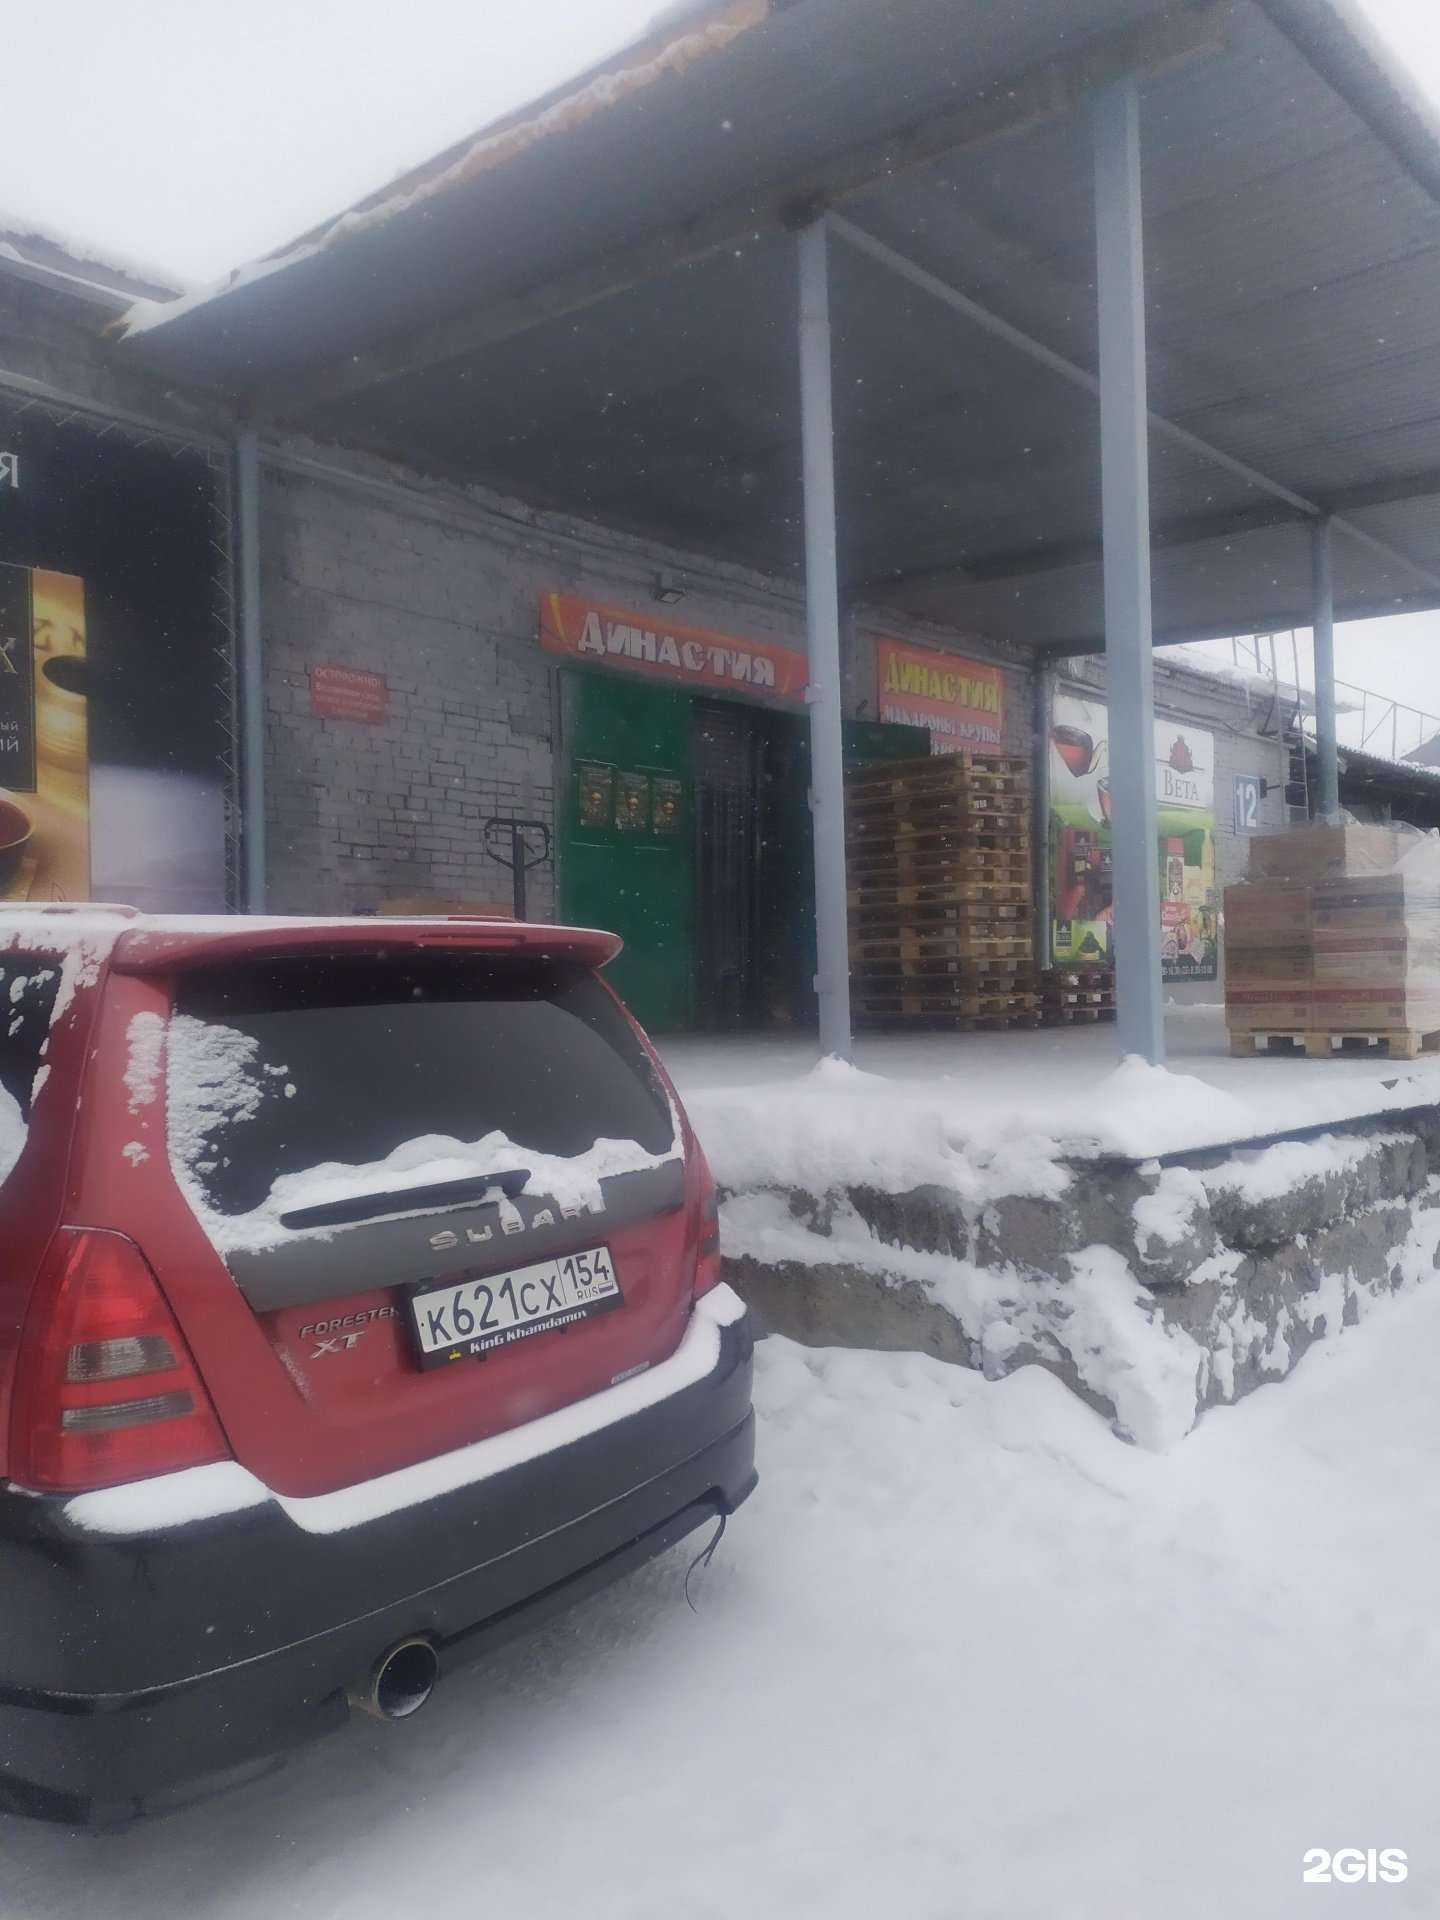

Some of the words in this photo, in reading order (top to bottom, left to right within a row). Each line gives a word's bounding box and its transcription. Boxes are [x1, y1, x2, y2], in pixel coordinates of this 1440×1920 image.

[577, 610, 776, 687] ДИНАСТИЯ
[884, 652, 999, 715] ДИНАСТИЯ
[1235, 781, 1258, 828] 12
[563, 1250, 609, 1290] 154
[576, 1287, 599, 1301] RUS
[310, 1330, 366, 1360] XT
